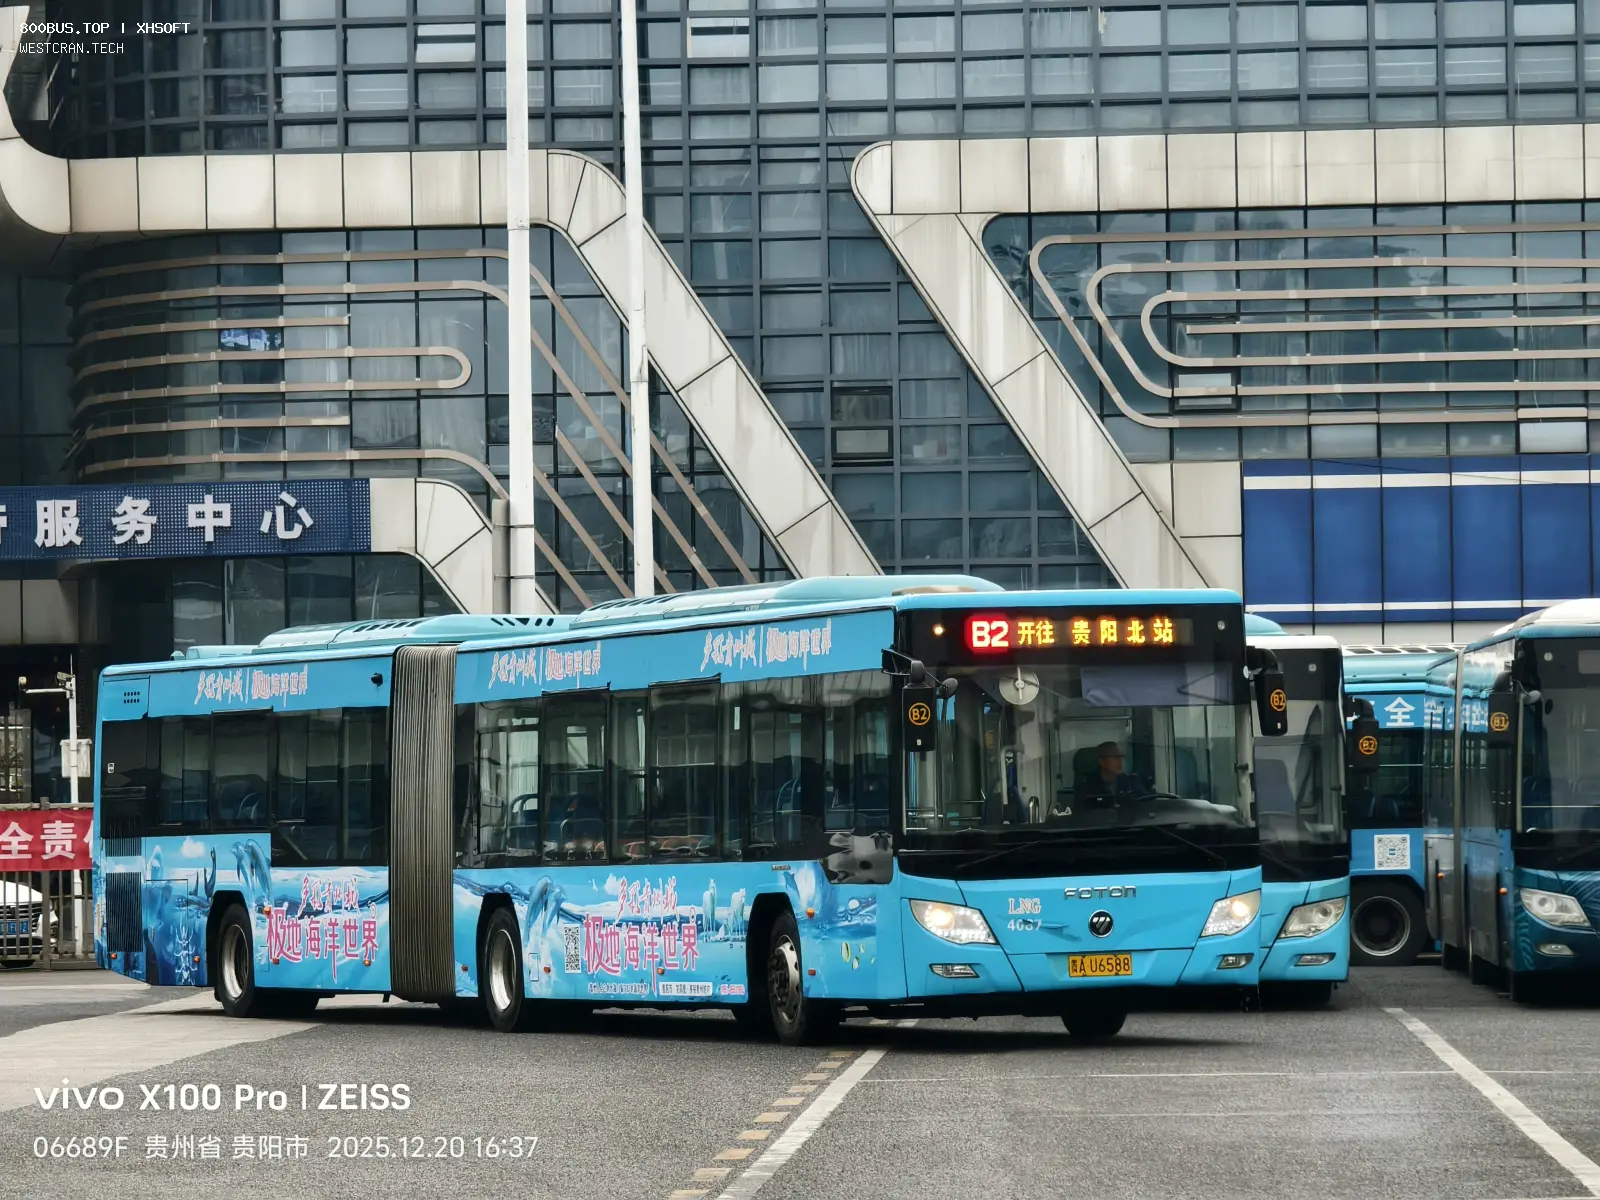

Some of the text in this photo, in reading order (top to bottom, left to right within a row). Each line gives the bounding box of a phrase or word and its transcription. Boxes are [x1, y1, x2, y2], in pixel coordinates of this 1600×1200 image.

[971, 618, 1174, 648] B2 开往 贵阳北站
[912, 708, 928, 721] B2
[1008, 897, 1042, 915] LNG
[266, 902, 379, 984] 极地海洋世界
[583, 907, 700, 997] 极地海洋世界
